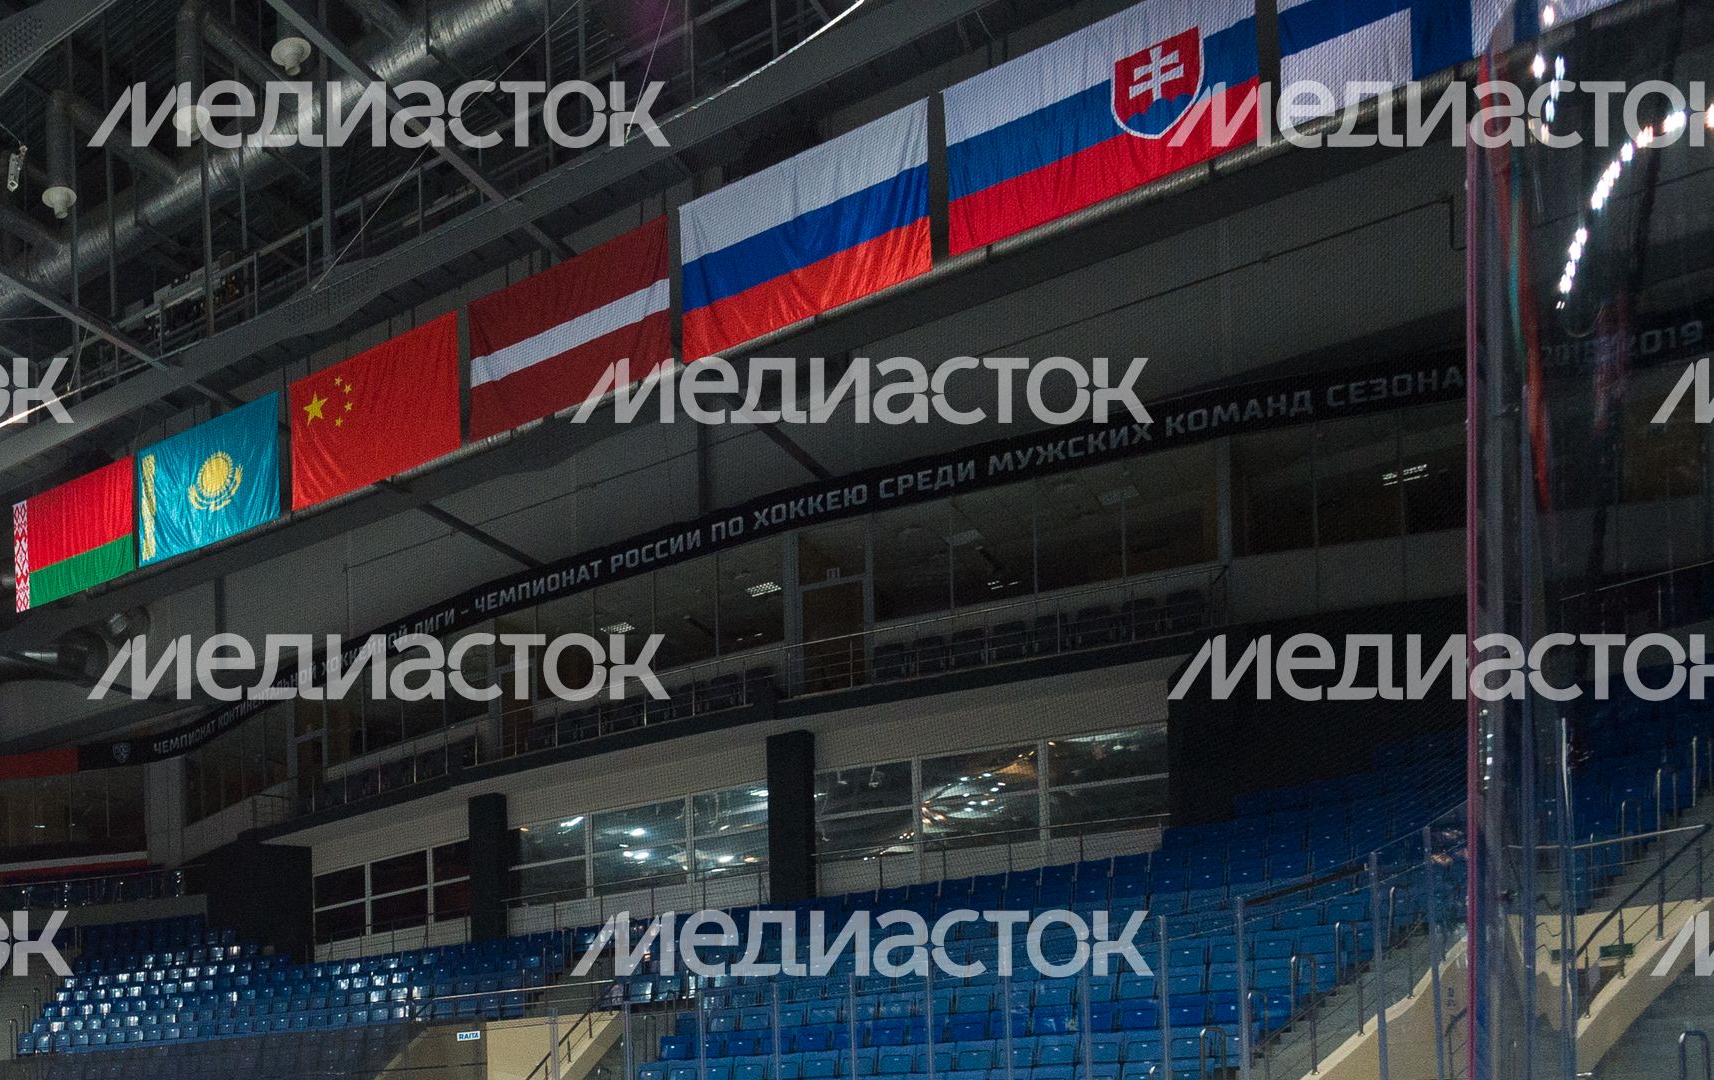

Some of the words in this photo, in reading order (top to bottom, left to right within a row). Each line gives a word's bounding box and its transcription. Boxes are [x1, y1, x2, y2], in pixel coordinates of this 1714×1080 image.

[153, 718, 217, 755] ЧЕМПИОНАТ
[412, 608, 455, 640] ЛИГИ
[475, 560, 603, 613] ЧЕМПИОНАТ
[611, 528, 702, 574] РОССИИ
[711, 516, 744, 542] ПО
[753, 483, 868, 530] ХОККЕЮ
[879, 459, 975, 499] СРЕДИ
[988, 422, 1152, 476] МУЖСКИХ
[1166, 391, 1313, 437] КОМАНД
[1326, 365, 1466, 407] СЕЗОНА
[458, 1032, 479, 1040] RAITA
